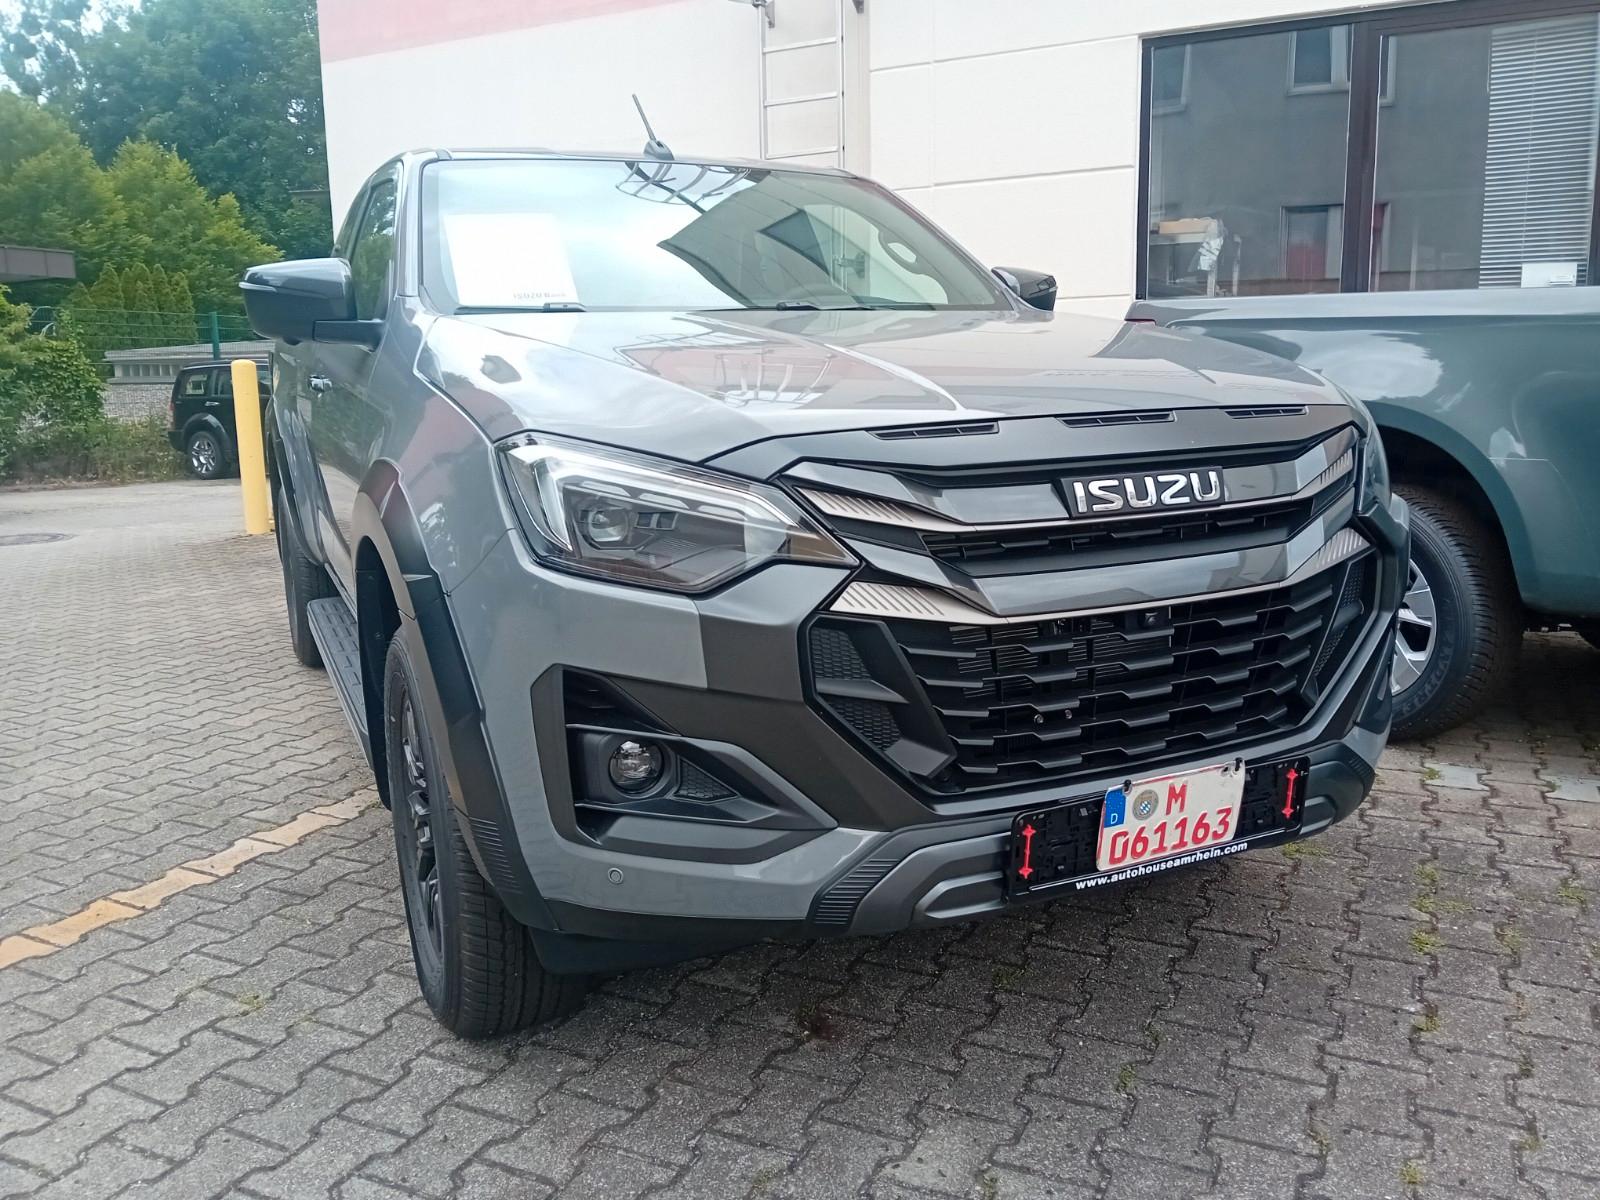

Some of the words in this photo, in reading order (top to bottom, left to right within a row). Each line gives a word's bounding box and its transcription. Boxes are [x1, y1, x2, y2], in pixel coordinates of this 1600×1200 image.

[1073, 471, 1221, 513] ISUZU
[1110, 812, 1119, 825] D
[1165, 783, 1188, 816] M
[1108, 807, 1232, 865] 061163
[1075, 842, 1248, 890] www.autohouseamrhein.com
